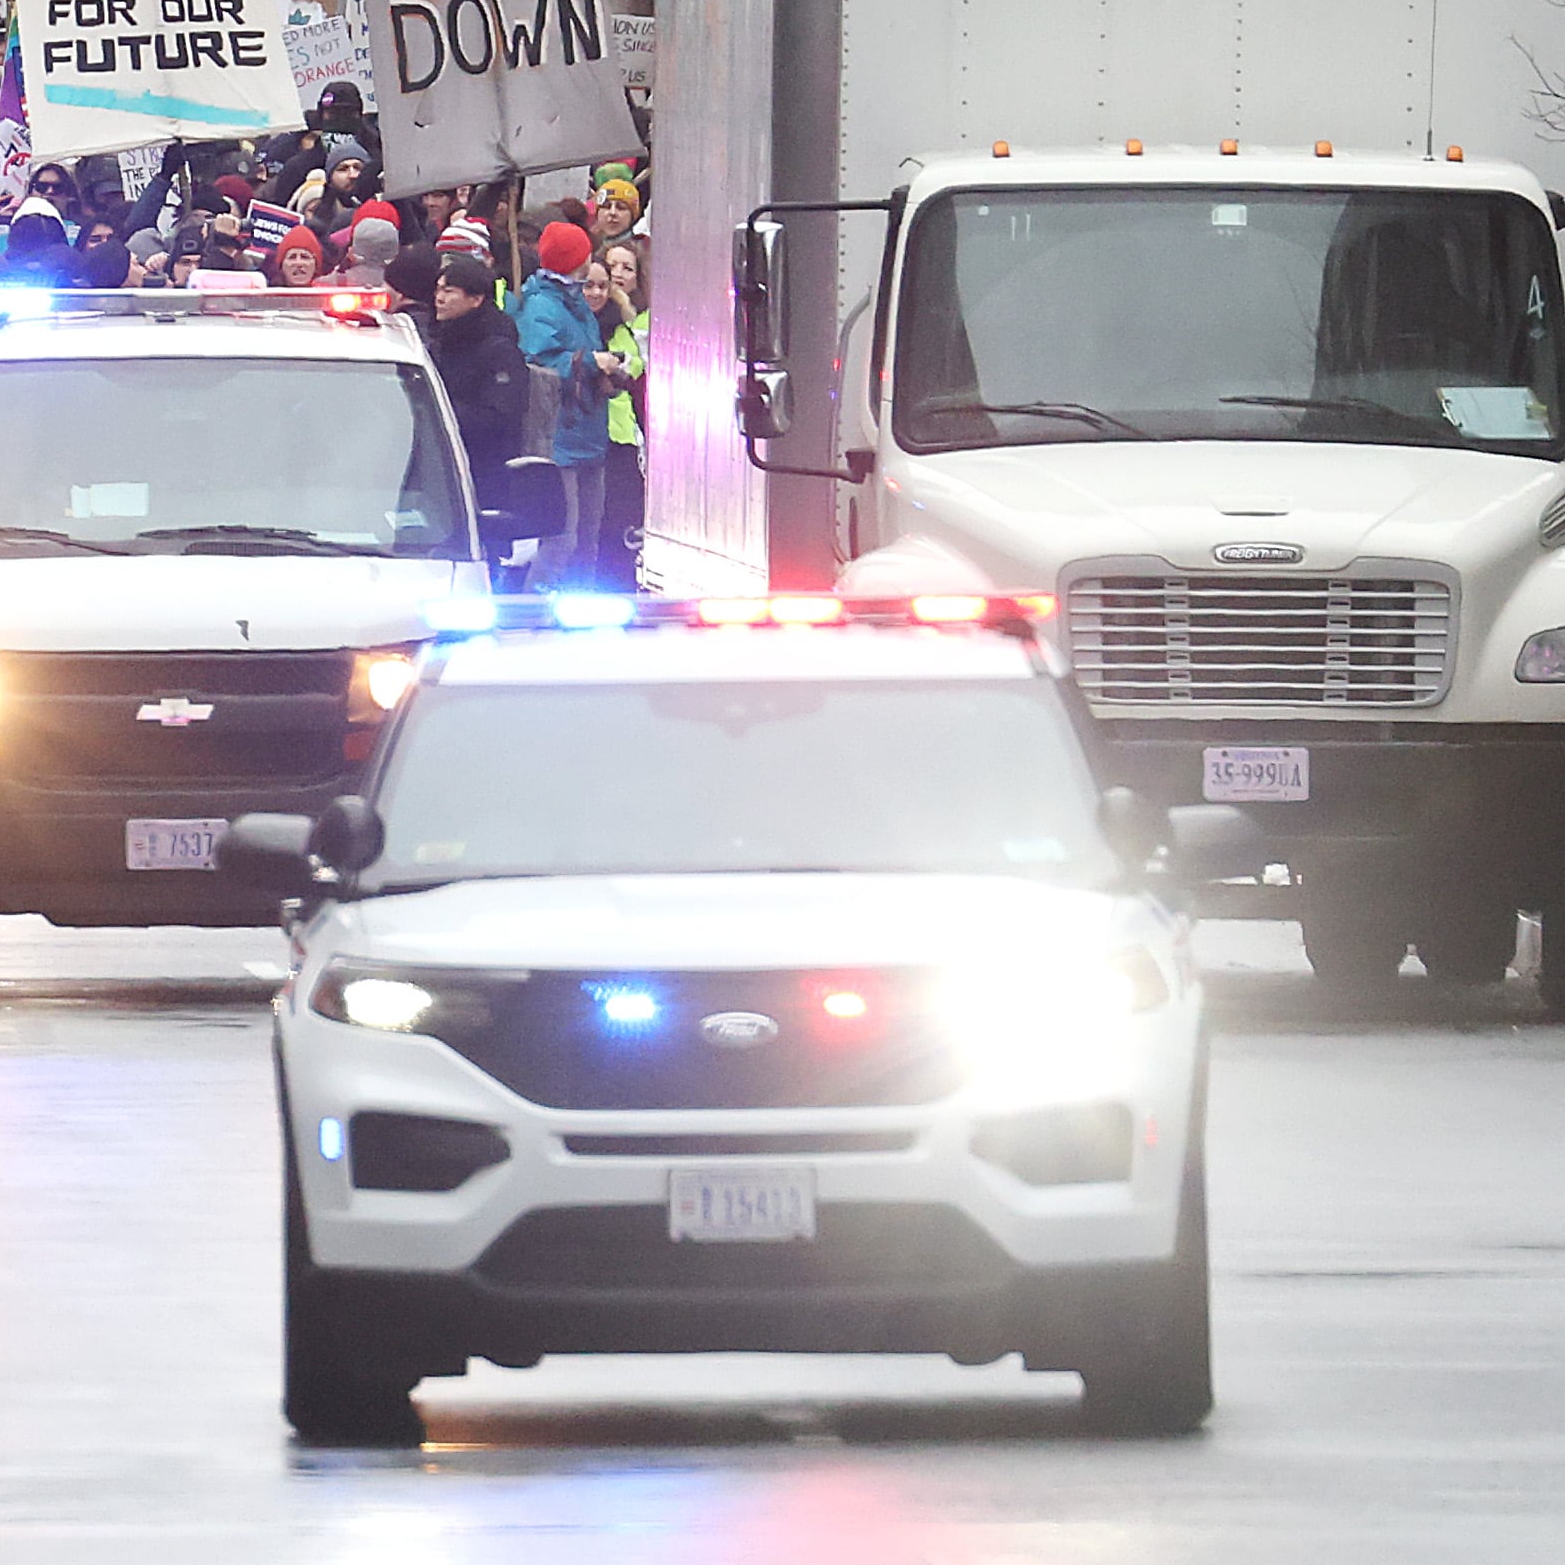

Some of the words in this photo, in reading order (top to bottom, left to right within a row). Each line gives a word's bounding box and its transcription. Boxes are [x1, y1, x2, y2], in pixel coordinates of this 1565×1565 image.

[304, 18, 341, 37] MORE
[43, 30, 268, 74] FUTURE
[314, 39, 341, 57] NOT
[294, 57, 355, 88] ORANGE
